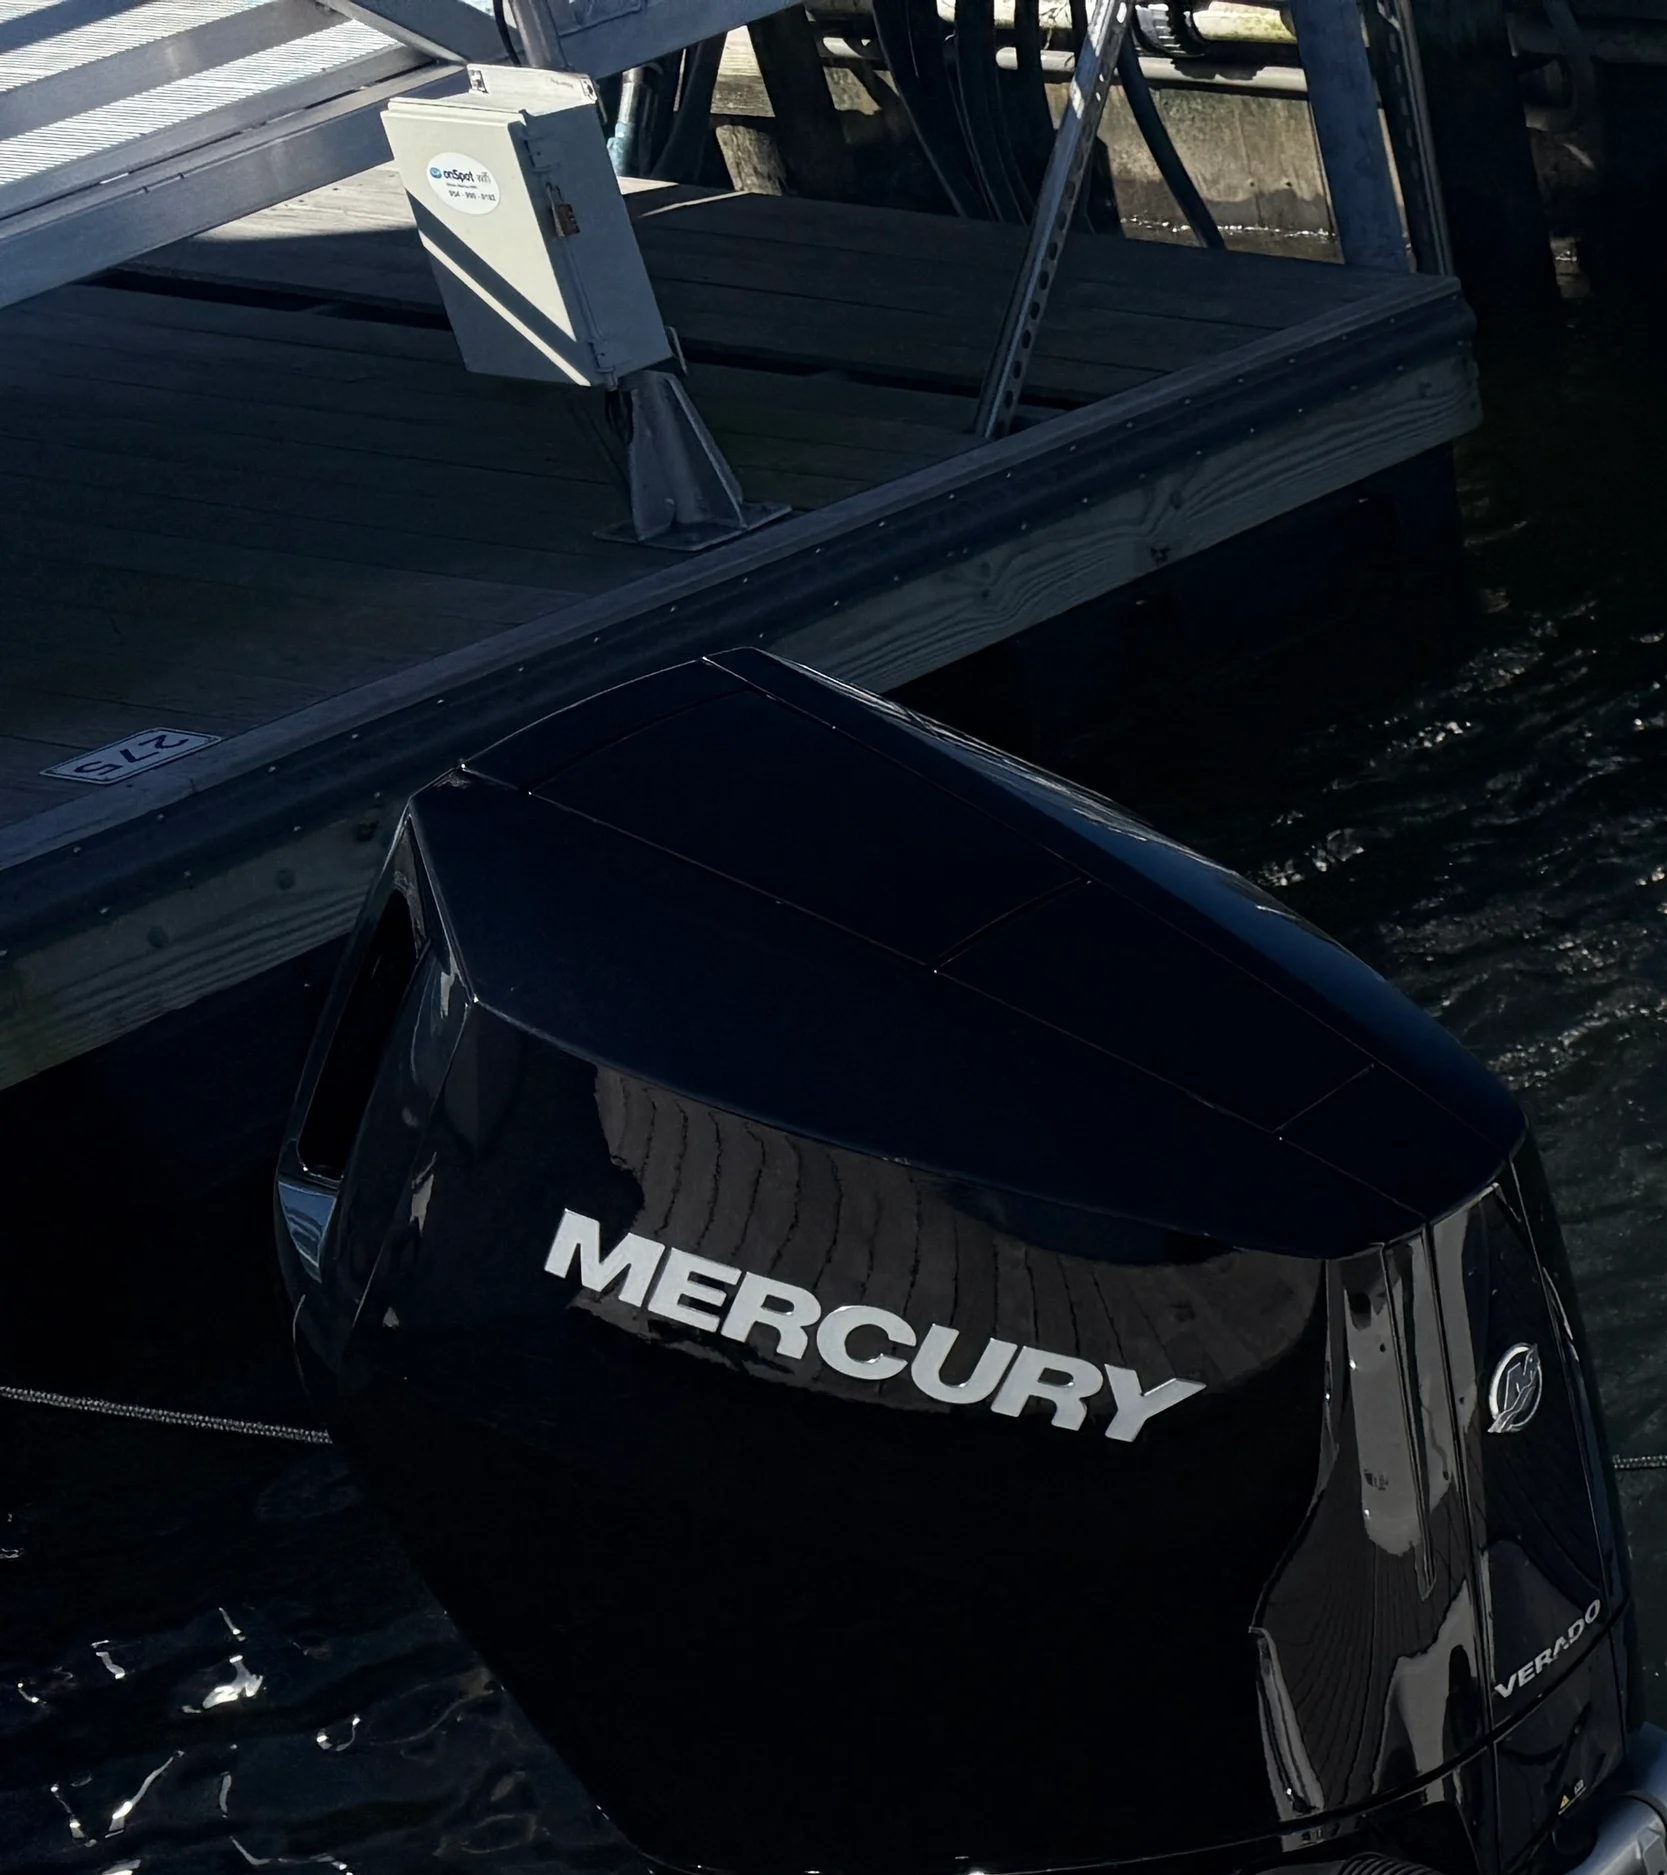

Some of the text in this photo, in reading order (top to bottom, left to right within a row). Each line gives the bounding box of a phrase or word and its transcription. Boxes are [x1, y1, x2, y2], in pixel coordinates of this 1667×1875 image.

[443, 169, 474, 182] onSpot
[74, 734, 189, 776] 275
[544, 1207, 1207, 1442] MERCURY
[1495, 1599, 1601, 1699] VERADO
